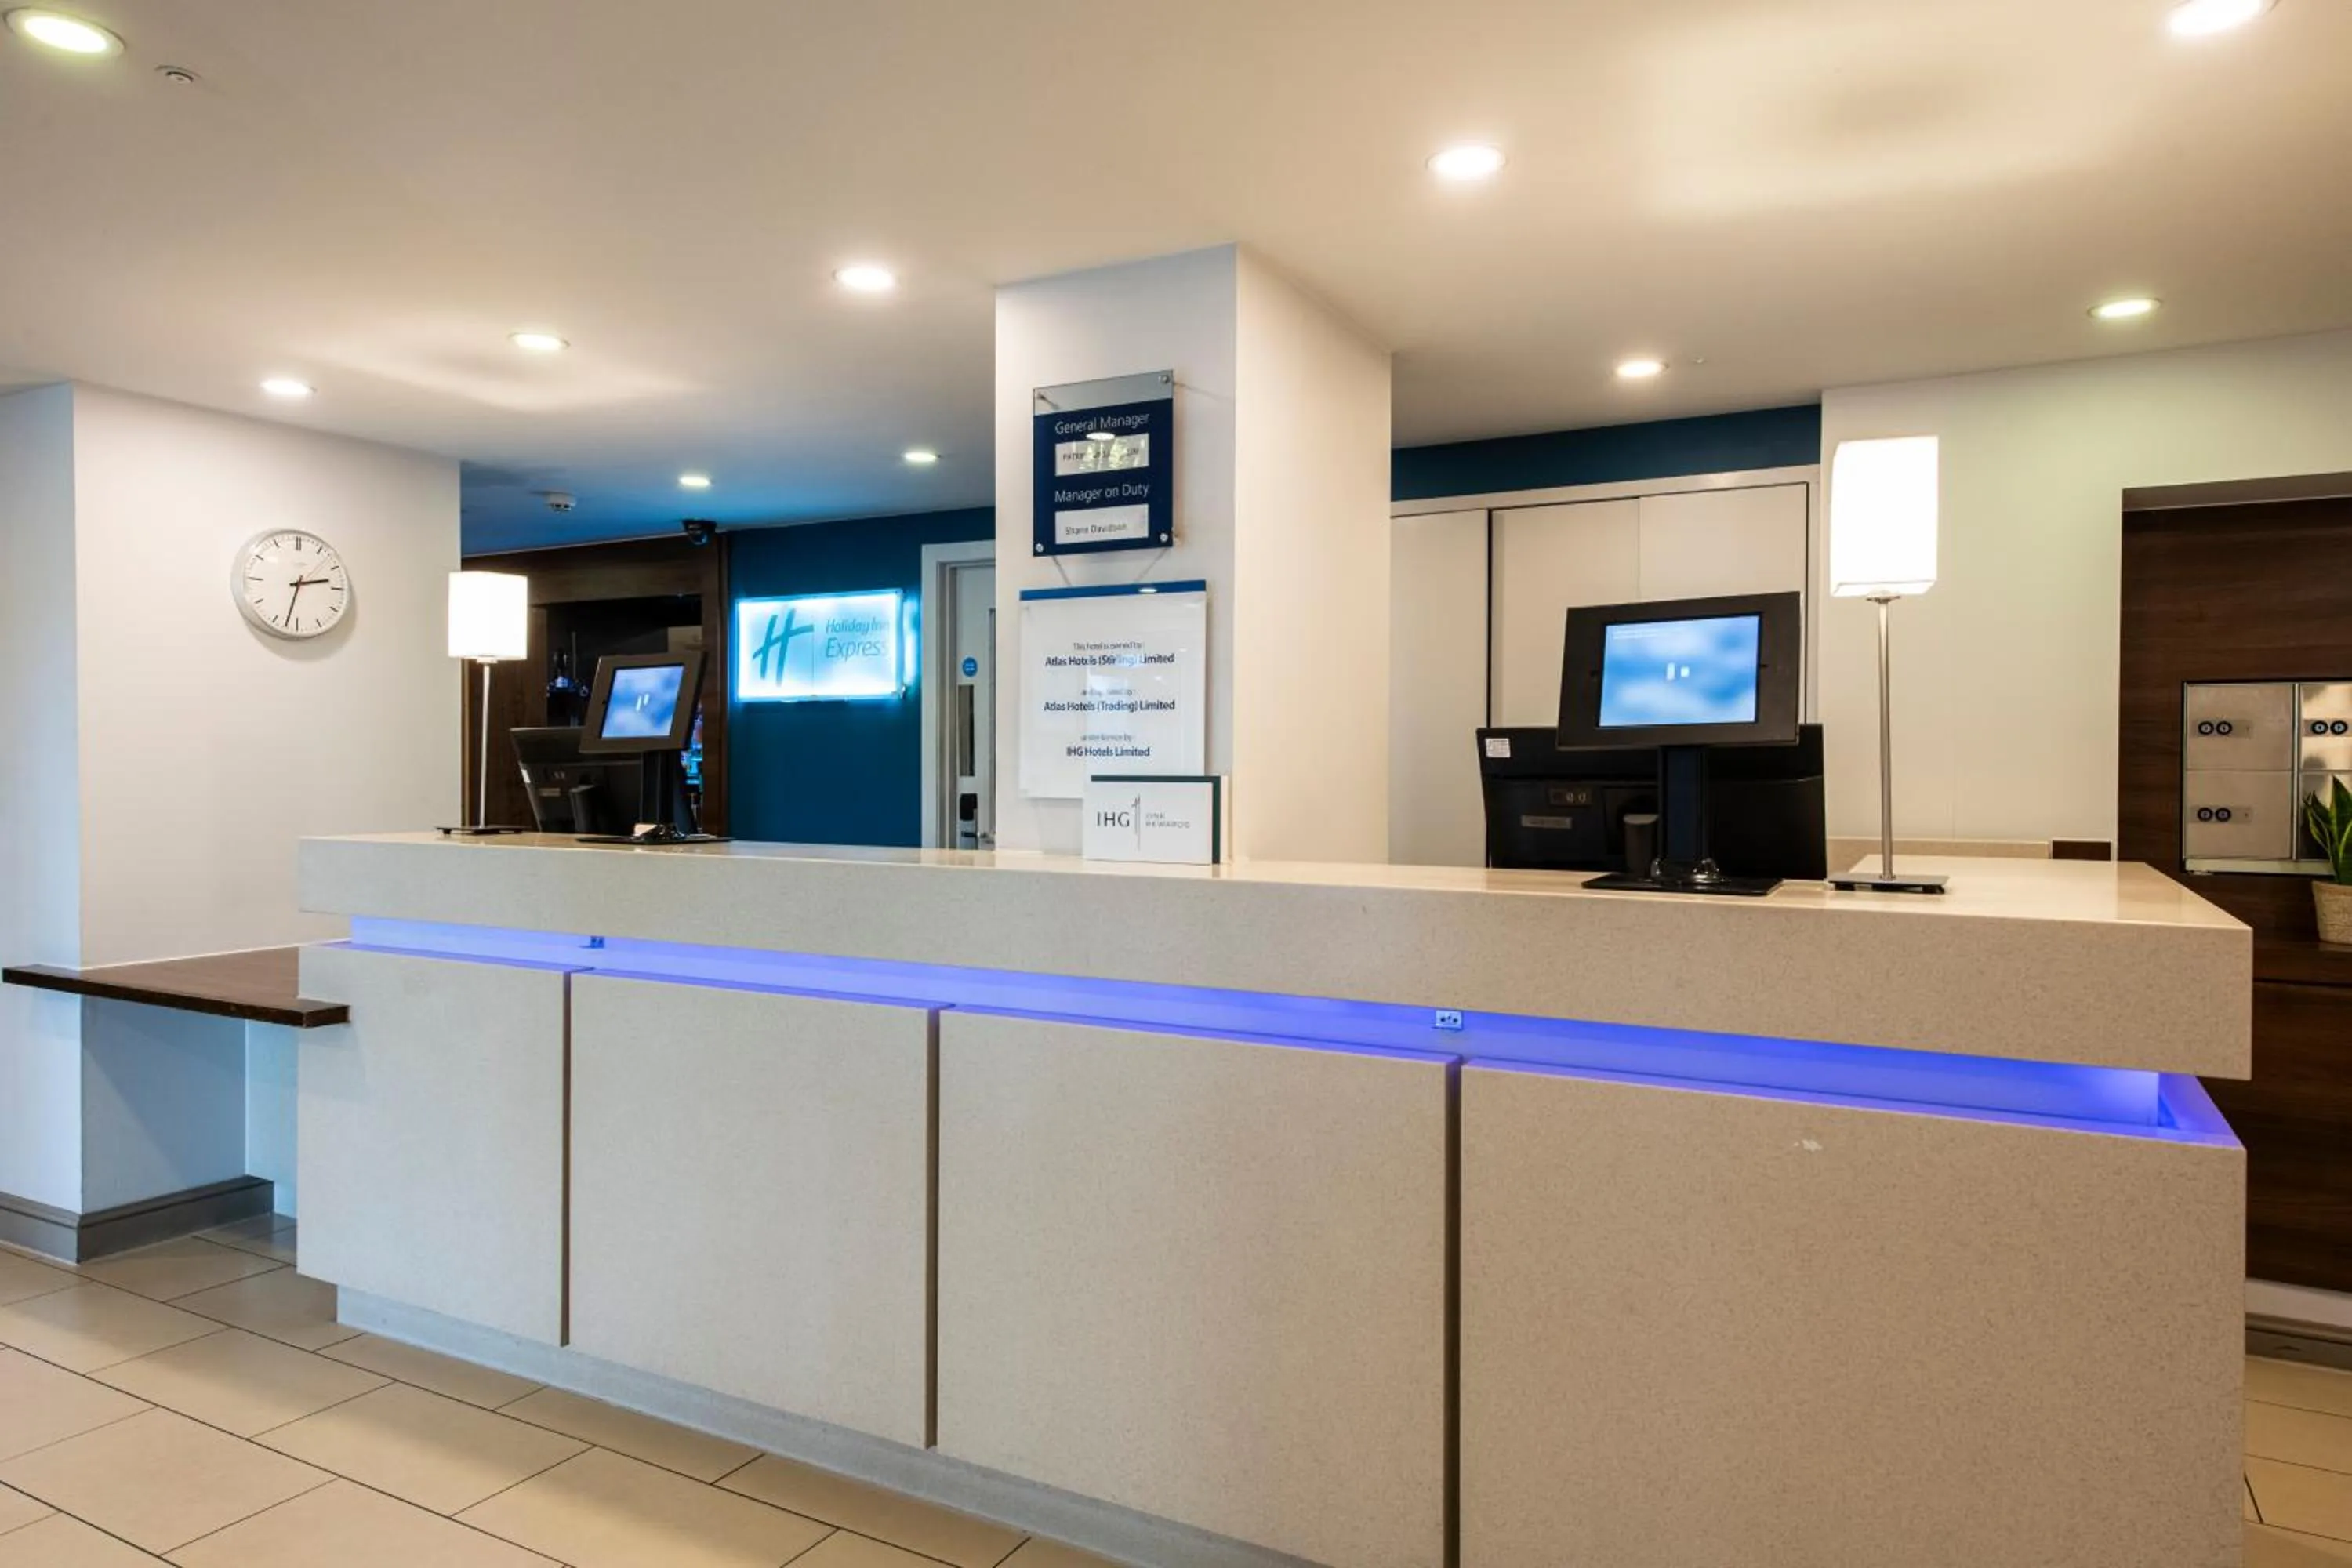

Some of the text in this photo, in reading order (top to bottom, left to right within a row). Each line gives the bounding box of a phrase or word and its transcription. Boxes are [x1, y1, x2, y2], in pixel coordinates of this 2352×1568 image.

[1054, 413, 1149, 434] General Manager
[1054, 484, 1149, 504] Manager on Duty
[826, 618, 869, 636] Holiday
[826, 637, 889, 662] Express
[1045, 656, 1067, 666] Atlas
[1069, 655, 1097, 666] Hotels
[1139, 653, 1174, 664] Limited
[1044, 699, 1174, 713] Atlas Hotels (Trading) Limited
[1066, 746, 1150, 757] IHG Hotels Limited
[1097, 811, 1130, 827] IHG
